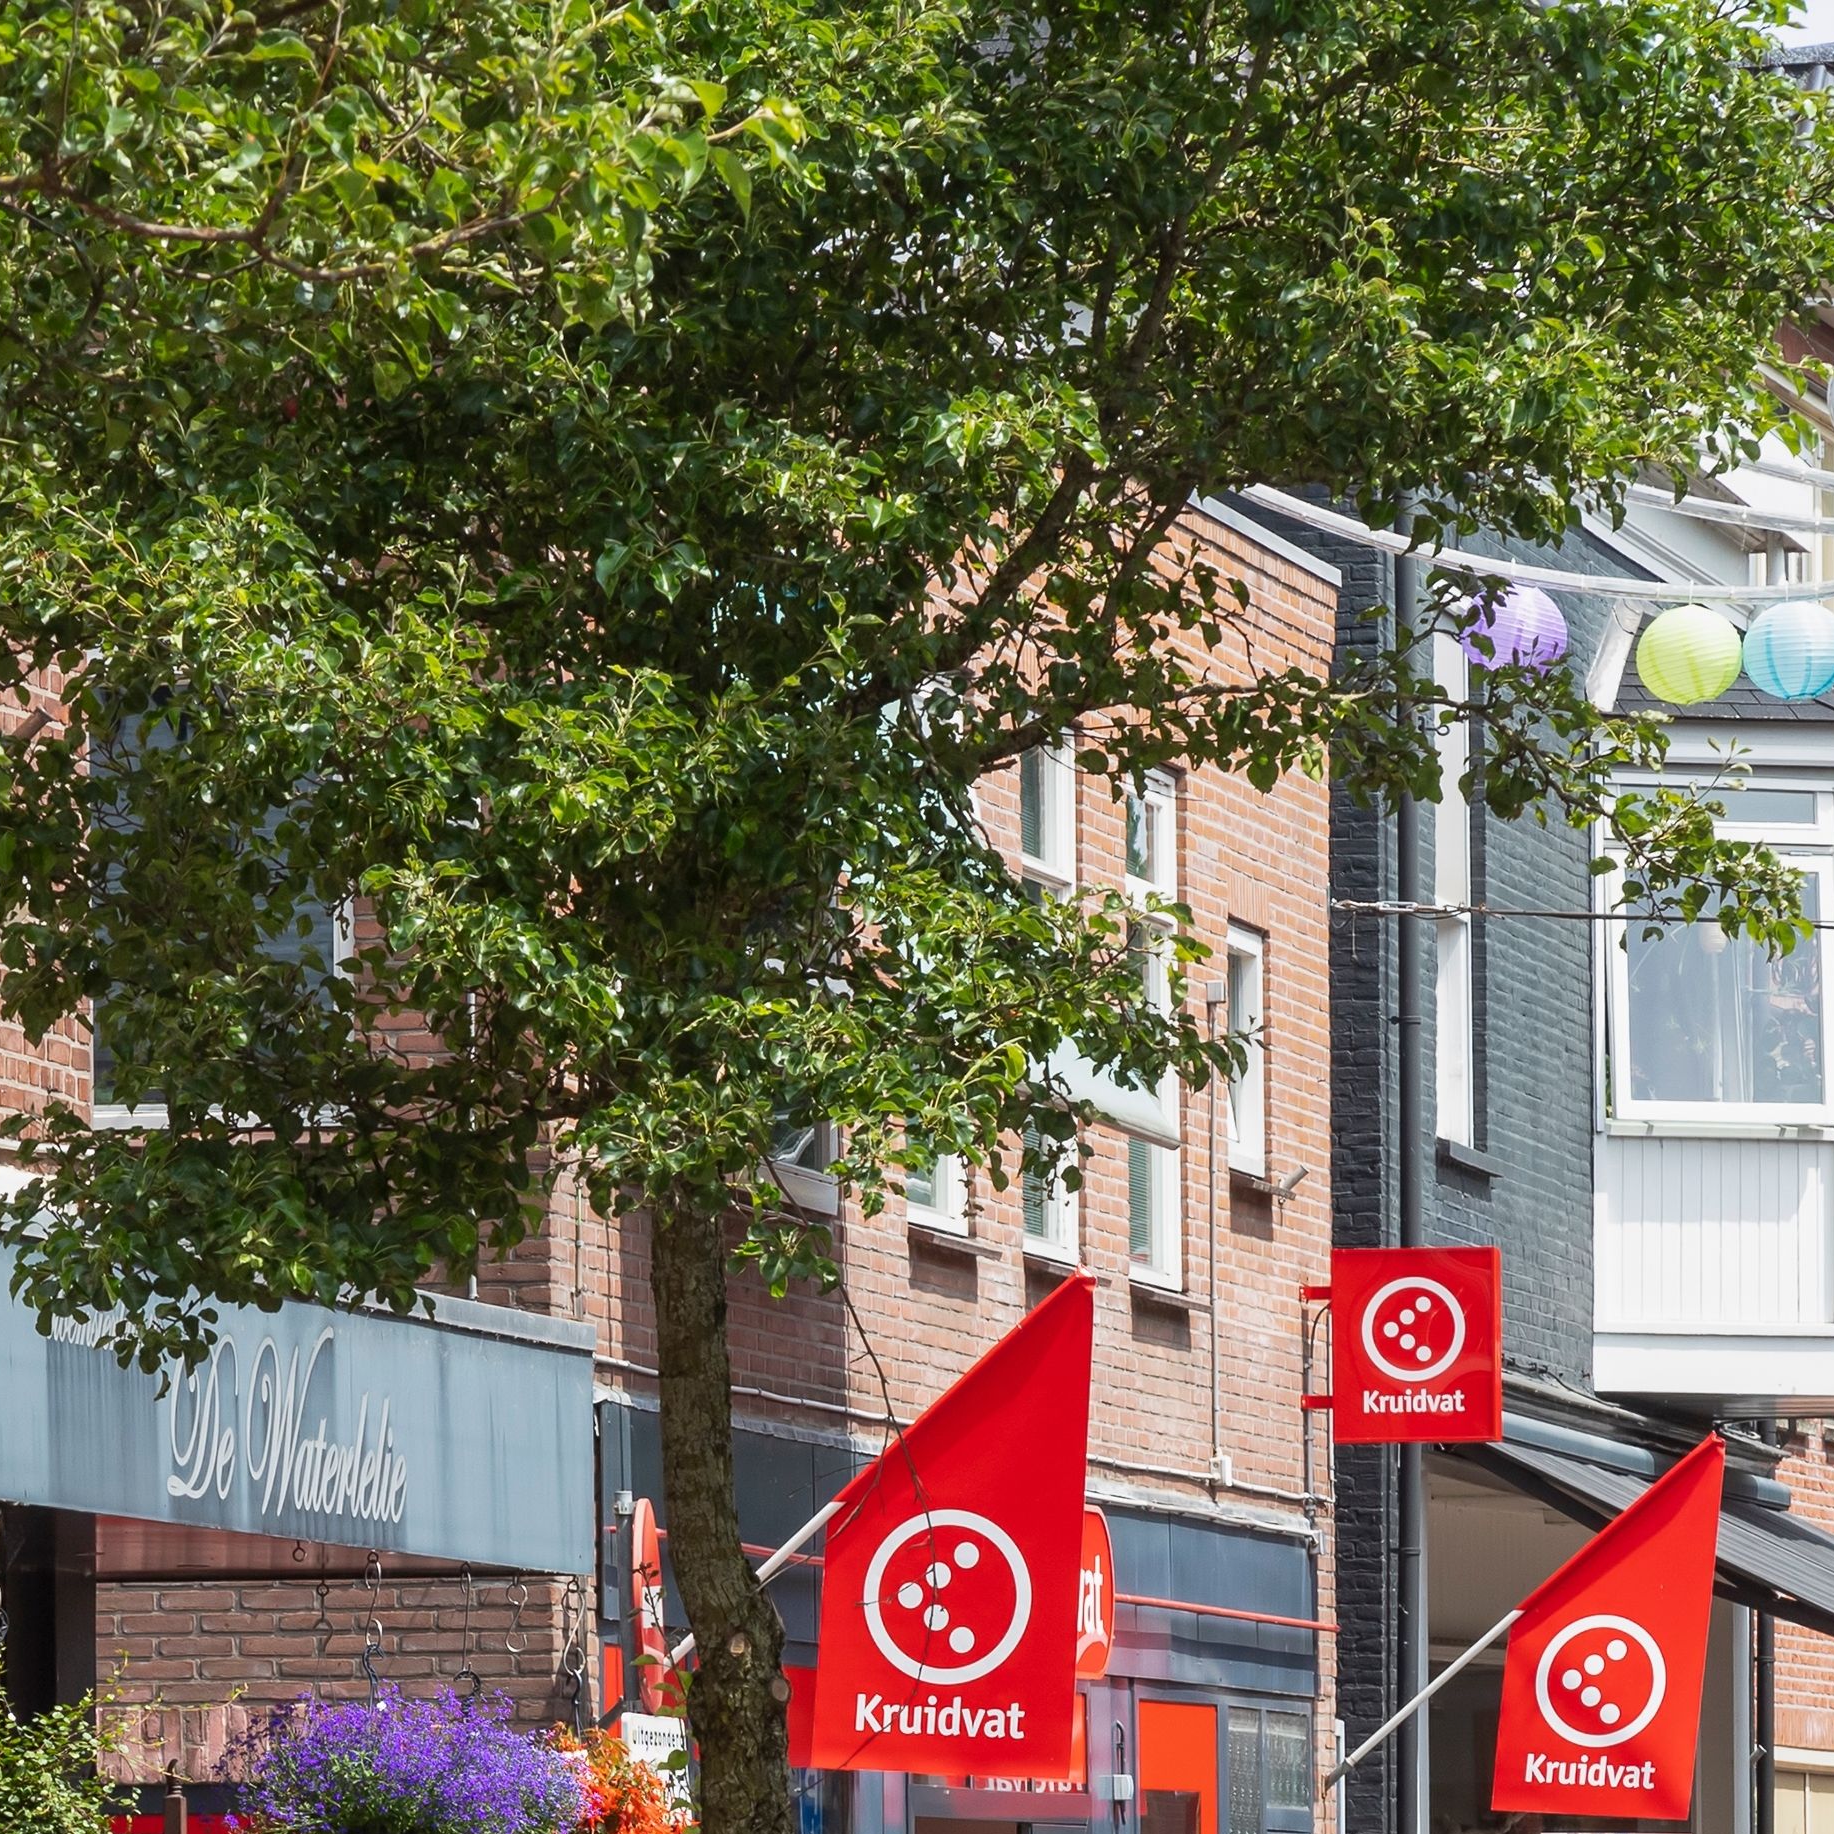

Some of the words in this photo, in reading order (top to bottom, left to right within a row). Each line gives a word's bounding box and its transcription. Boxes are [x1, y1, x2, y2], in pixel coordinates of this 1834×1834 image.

[1362, 1387, 1466, 1414] Kruidvat
[166, 1333, 239, 1500] De
[246, 1325, 407, 1523] Waterlelie
[854, 1691, 1026, 1740] Kruidvat
[1524, 1752, 1657, 1791] Kruidvat
